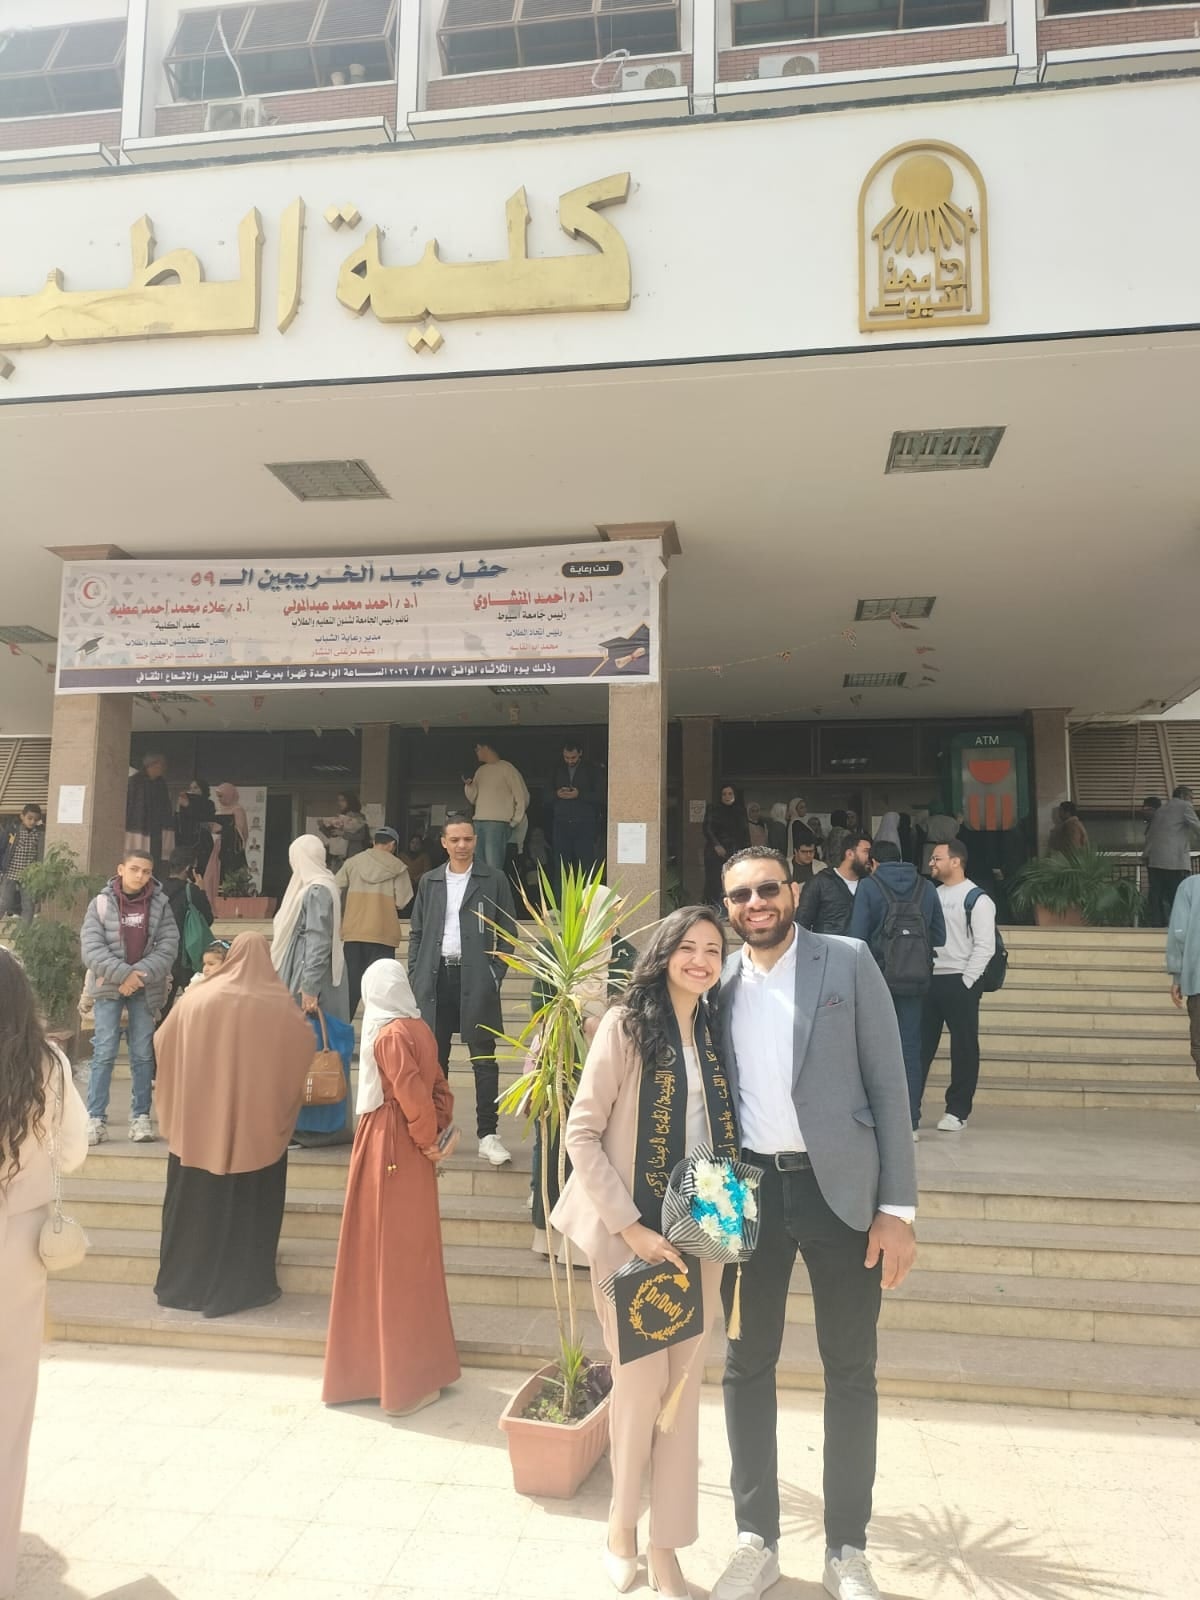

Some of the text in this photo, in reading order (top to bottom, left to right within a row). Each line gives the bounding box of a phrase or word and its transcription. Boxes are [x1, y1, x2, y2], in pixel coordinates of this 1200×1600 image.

[323, 171, 631, 355] كلية
[445, 558, 509, 587] حفل
[569, 564, 609, 575] تحت رعاية
[190, 570, 216, 587] ٥٩
[257, 562, 374, 593] الخريجين
[379, 565, 441, 587] عيد
[171, 601, 200, 614] محمد
[332, 598, 362, 611] محمد
[309, 668, 341, 679] الواحدة
[343, 667, 387, 677] الساعة
[450, 664, 478, 677] الموافق
[480, 663, 511, 674] الثلاثاء
[513, 665, 530, 675] يوم
[532, 662, 556, 674] وذلك
[231, 669, 253, 681] النيل
[255, 669, 284, 681] بمركز
[975, 735, 1000, 745] ATM
[645, 1286, 684, 1322] Dr/Dody
